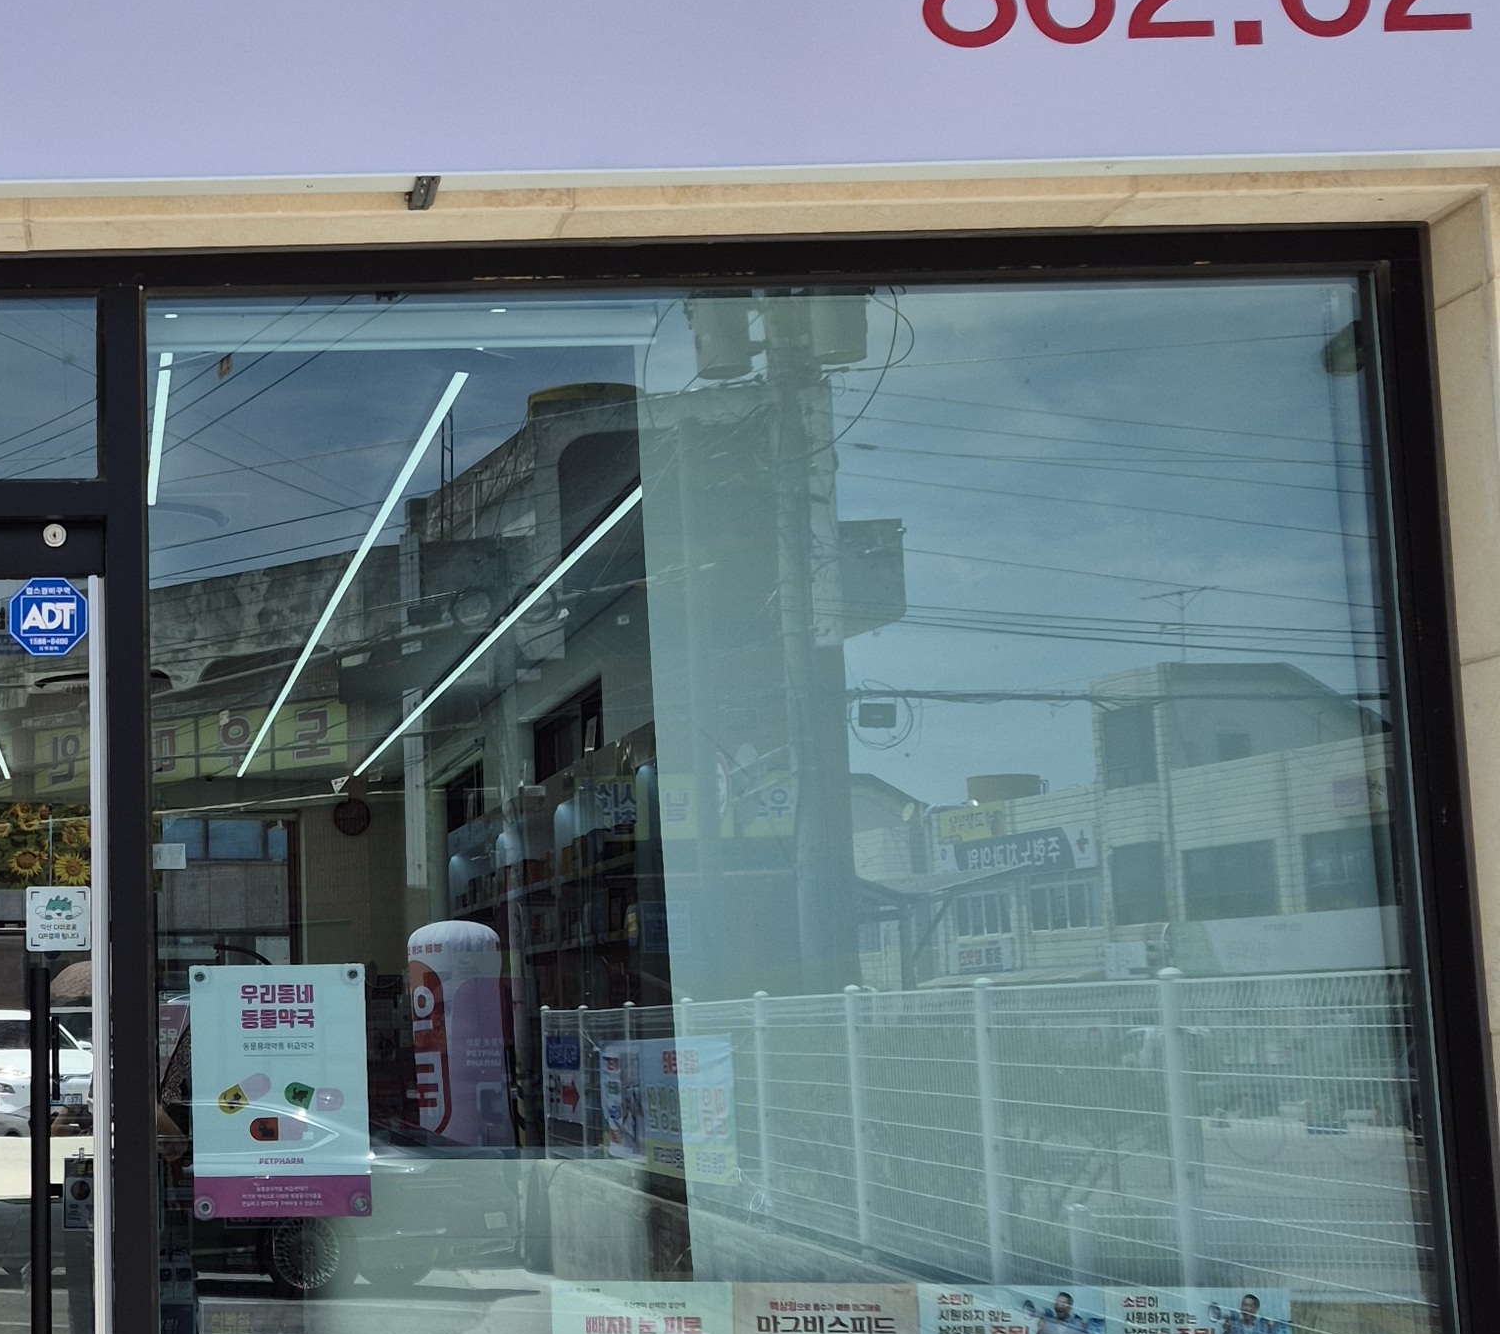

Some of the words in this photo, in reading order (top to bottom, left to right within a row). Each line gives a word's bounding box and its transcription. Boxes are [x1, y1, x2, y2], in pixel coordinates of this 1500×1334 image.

[22, 601, 76, 631] ADT
[240, 984, 314, 1004] 우리동네
[240, 1008, 314, 1029] 동물약국
[937, 1293, 973, 1306] 소변이
[1123, 1296, 1159, 1308] 소변이
[756, 1315, 896, 1334] 마그비스피드
[1125, 1312, 1170, 1324] 시원하지
